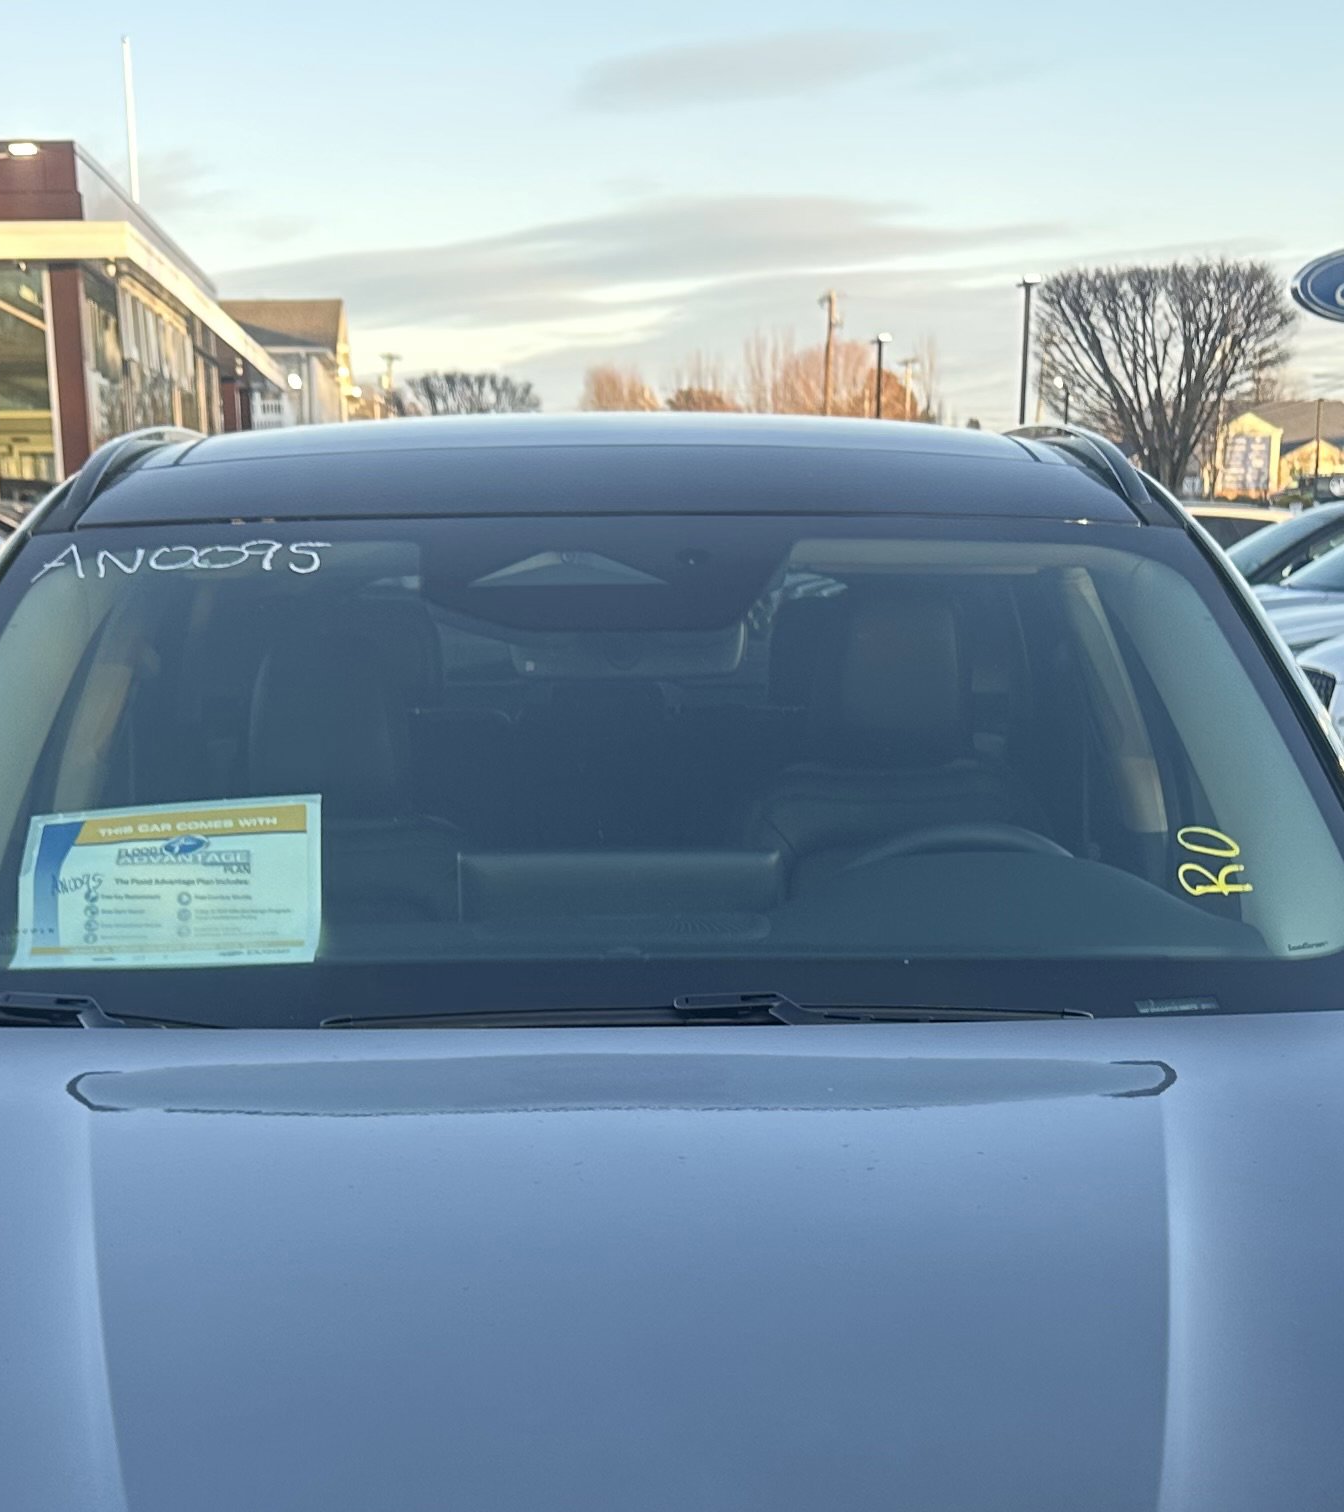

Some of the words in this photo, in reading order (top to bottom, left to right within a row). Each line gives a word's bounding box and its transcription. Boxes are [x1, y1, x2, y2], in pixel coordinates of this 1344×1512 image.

[98, 825, 133, 837] THIS
[138, 821, 172, 833] CAR
[176, 818, 234, 831] COMES
[238, 816, 278, 828] WITH
